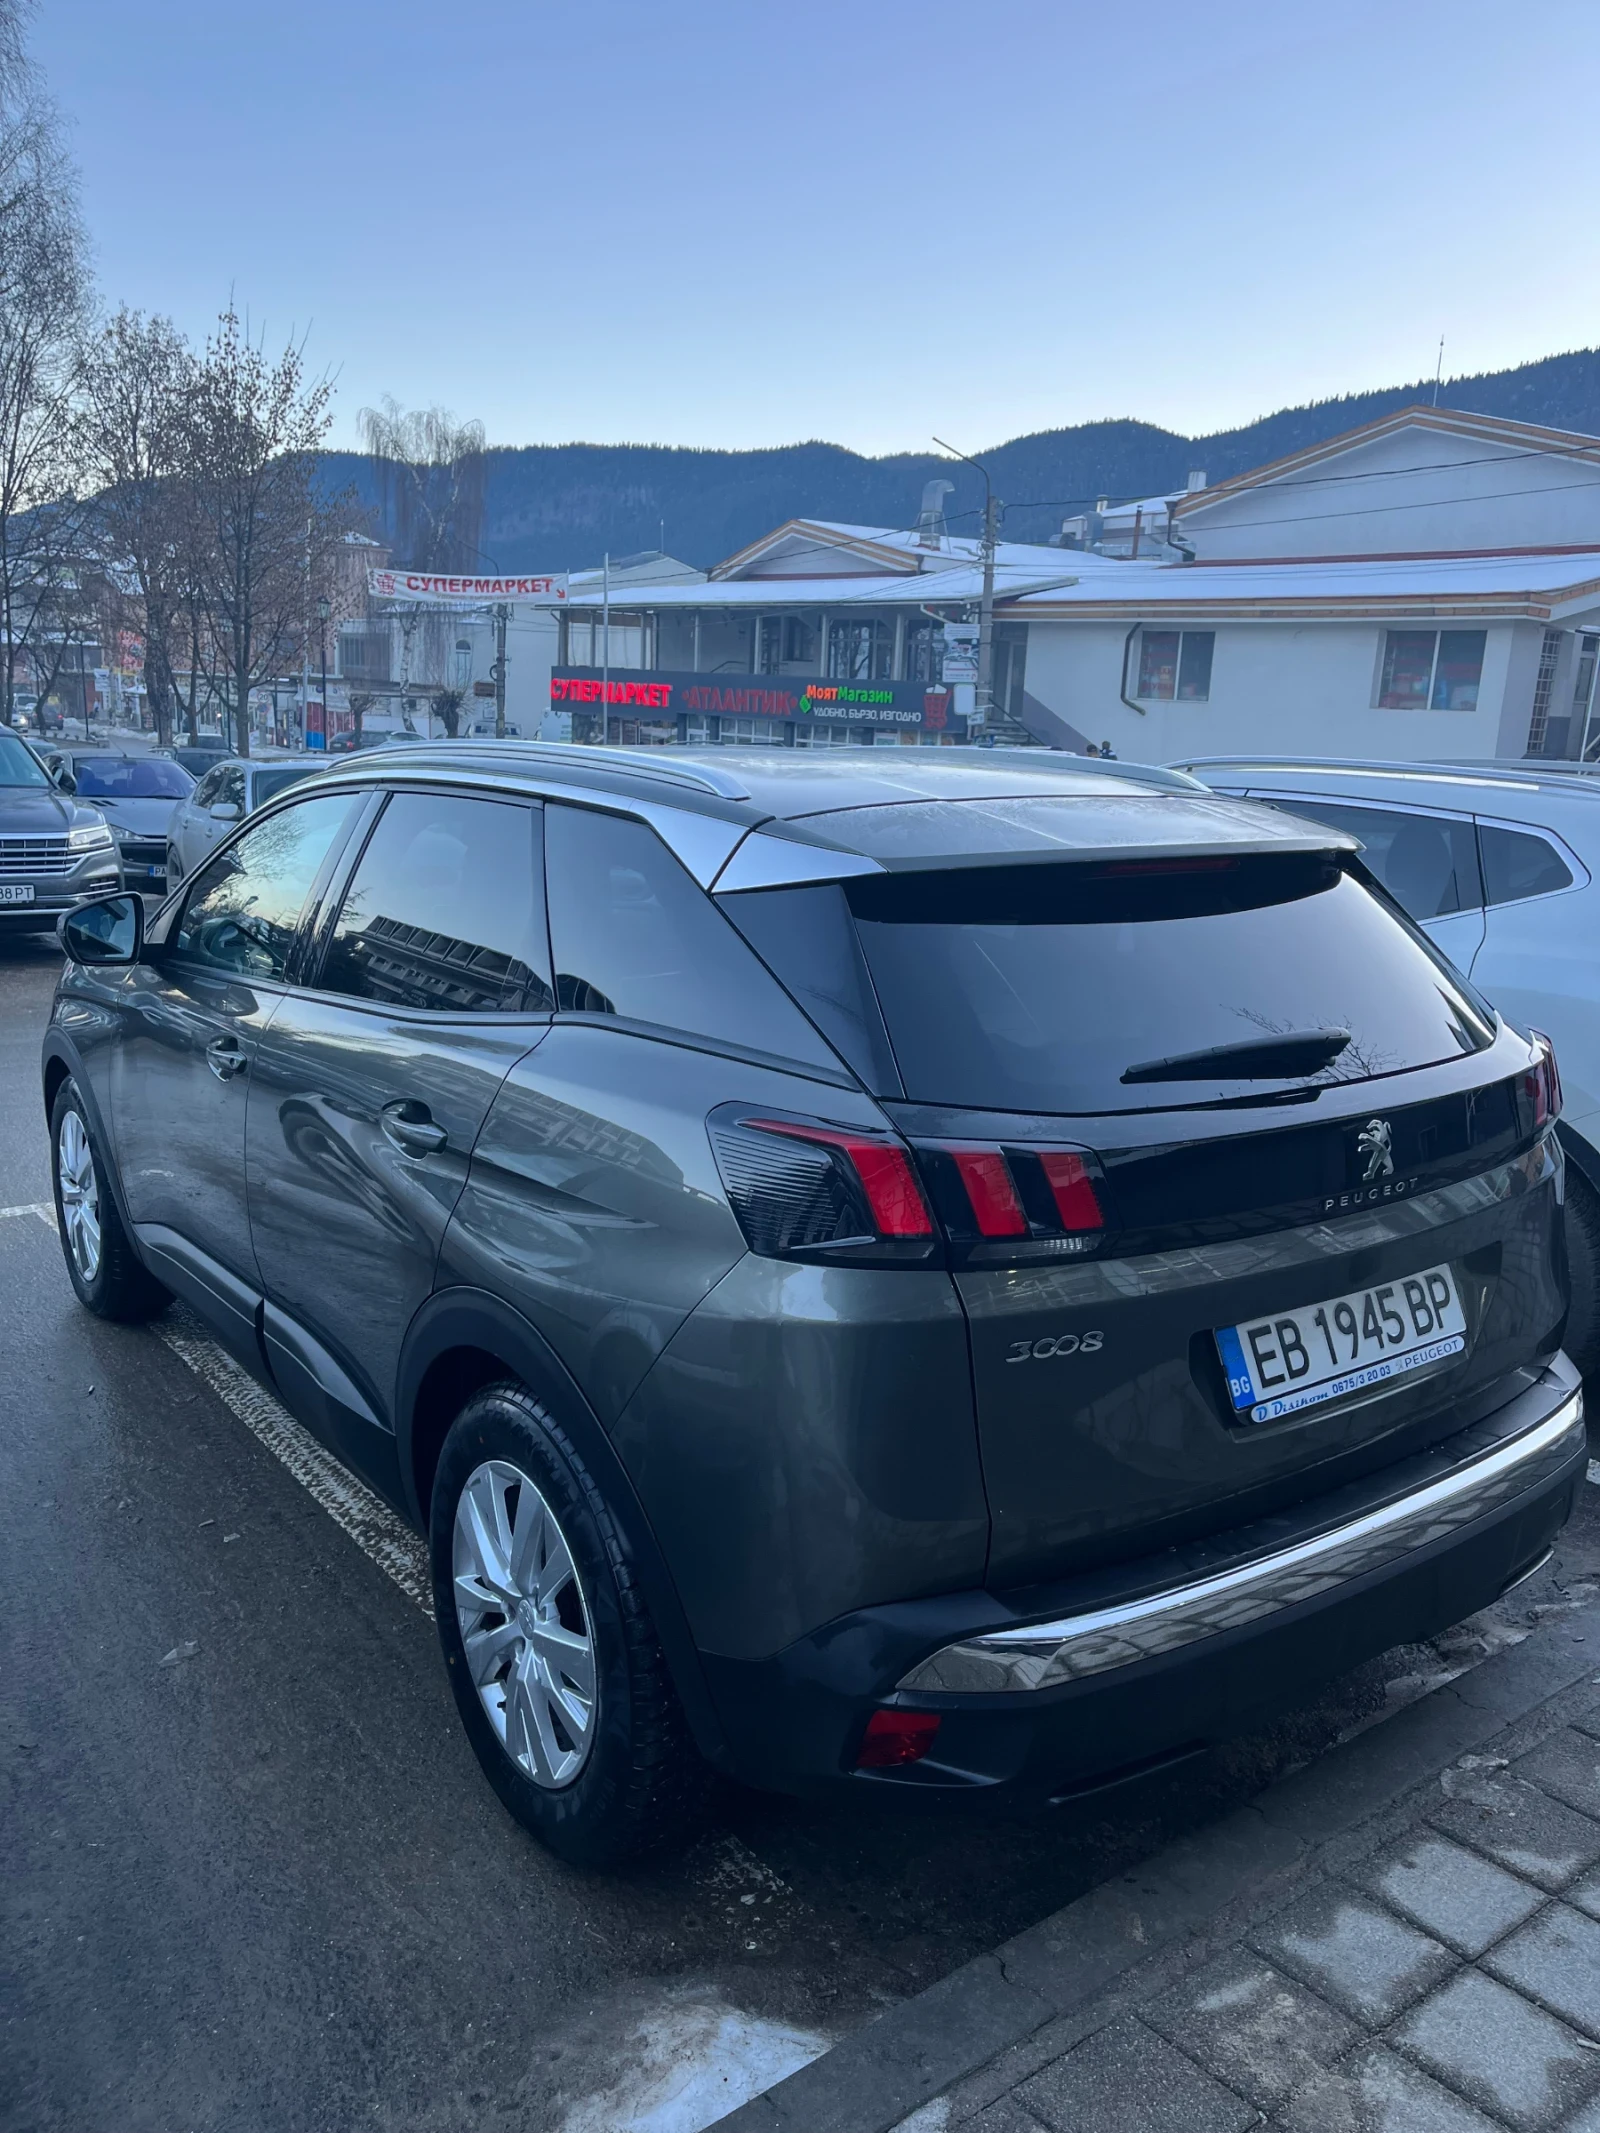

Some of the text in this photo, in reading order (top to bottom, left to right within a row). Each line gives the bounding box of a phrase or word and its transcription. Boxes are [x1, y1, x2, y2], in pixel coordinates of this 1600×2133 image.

[406, 576, 554, 593] СУПЕРМАРКЕТ
[550, 678, 791, 715] СУПЕРМАРКЕТ АТЛАНТИК
[813, 707, 921, 722] УДОБНО, БЪРЗО, ИЗГОДНО
[15, 887, 32, 899] PT
[1325, 1178, 1418, 1210] PEUGEOT
[1005, 1330, 1104, 1362] 3008
[1247, 1272, 1450, 1388] EB 1945 BP
[1332, 1374, 1365, 1394] 0675/3
[1367, 1369, 1378, 1381] 20
[1380, 1365, 1391, 1377] 03
[1404, 1340, 1459, 1367] PEUGEOT
[1229, 1376, 1250, 1397] BG
